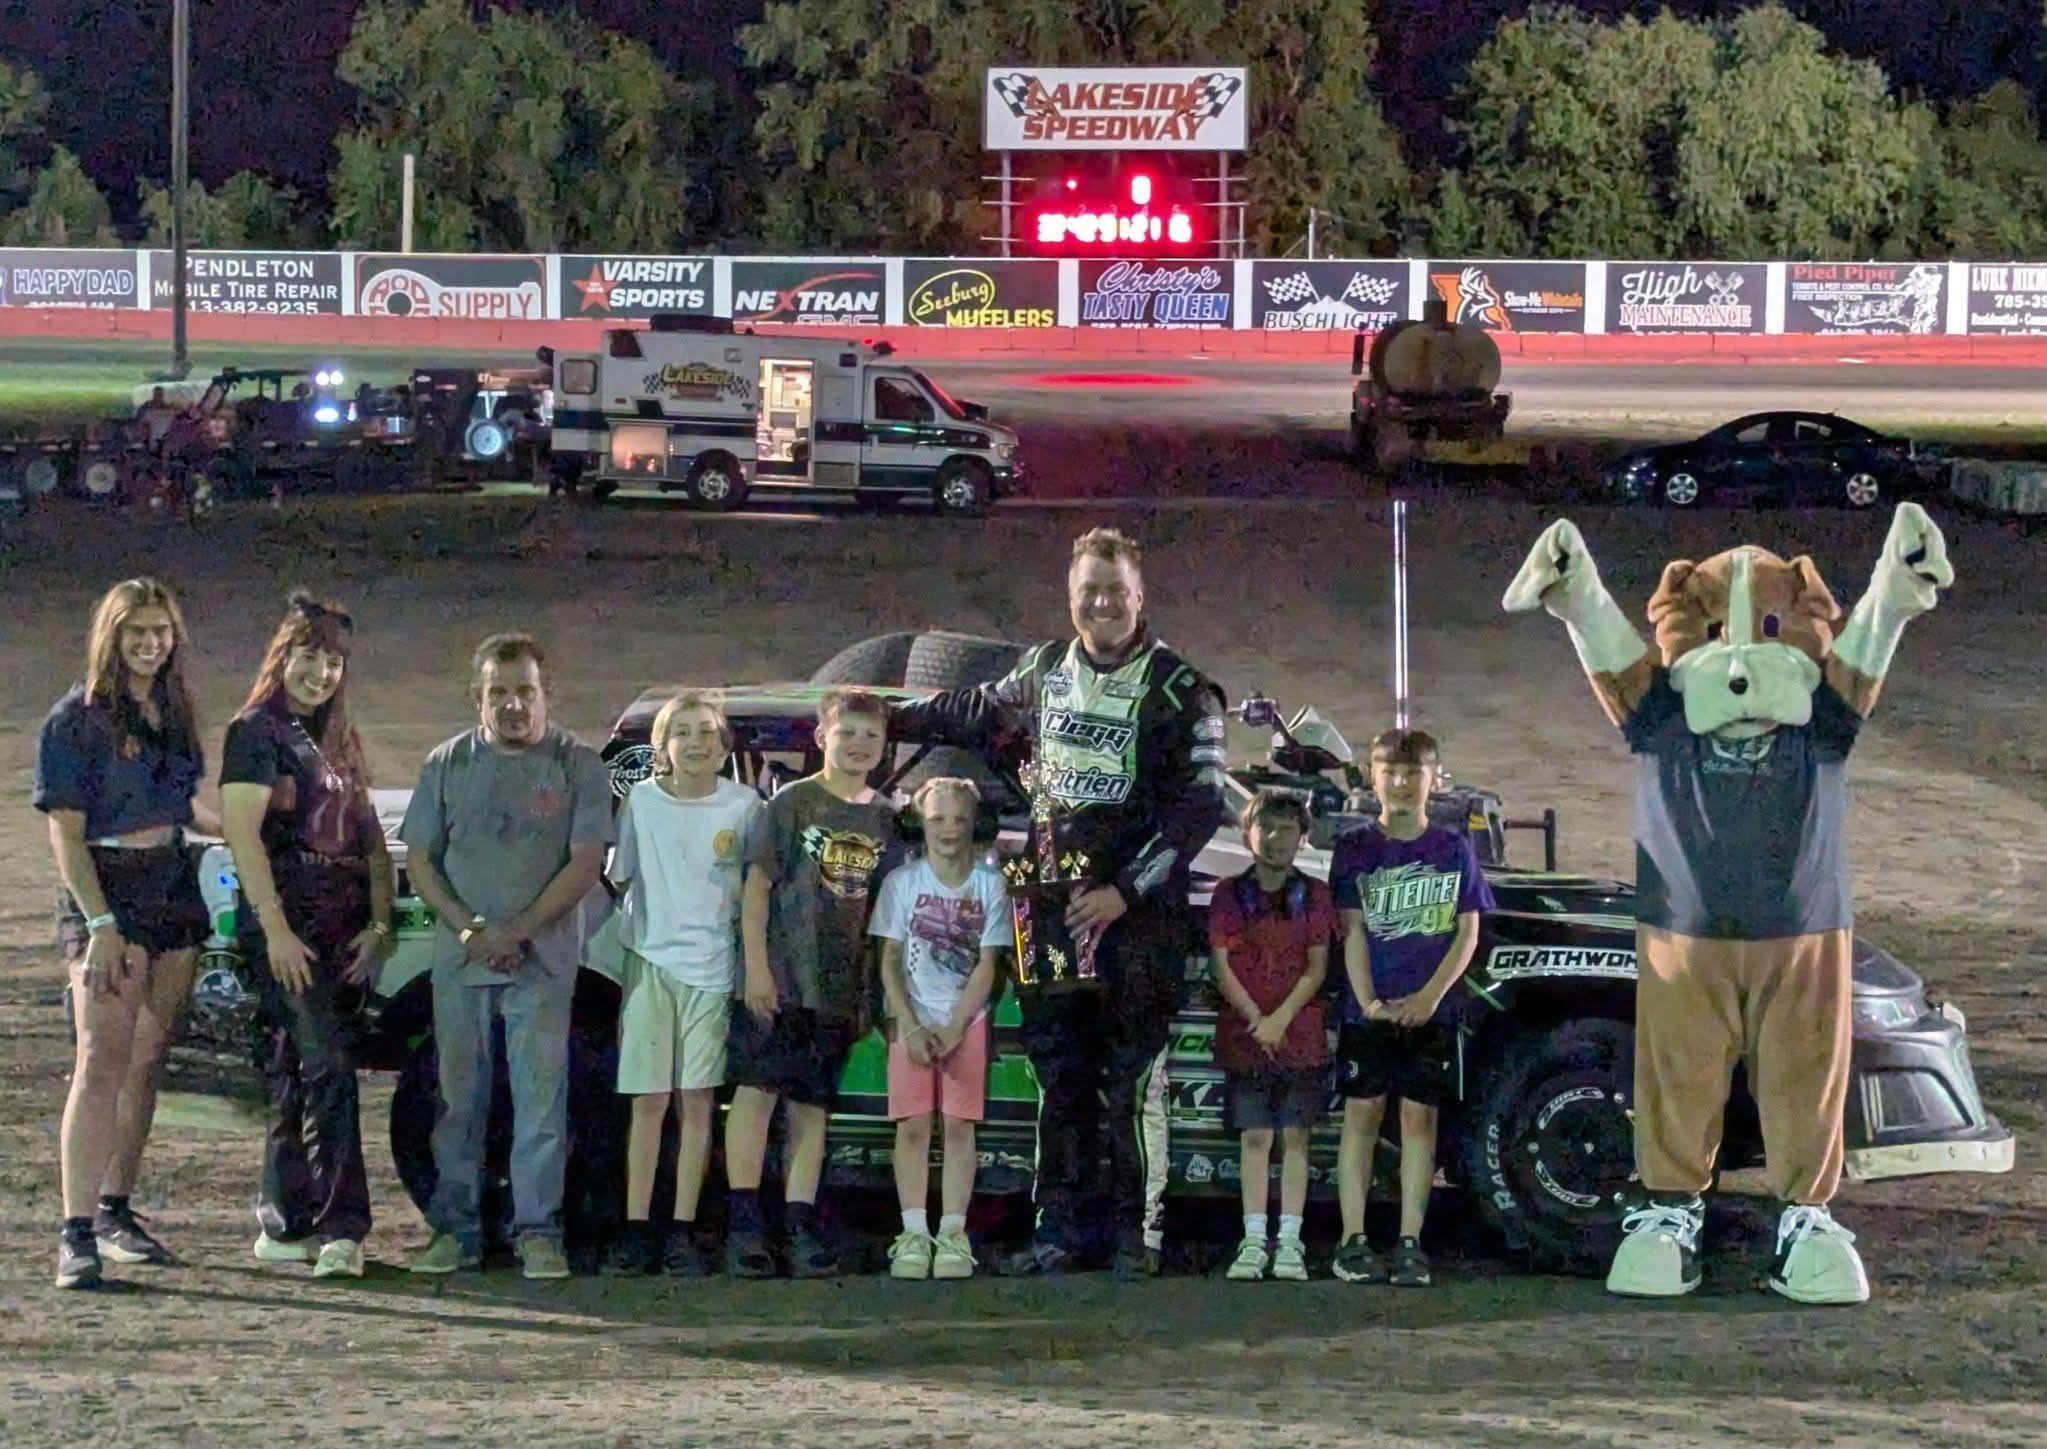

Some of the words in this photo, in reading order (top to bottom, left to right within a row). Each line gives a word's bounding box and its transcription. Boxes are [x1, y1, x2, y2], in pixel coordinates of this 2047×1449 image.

[1025, 80, 1210, 112] LAKESIDE
[1022, 115, 1206, 141] SPEEDWAY
[602, 261, 704, 283] VARSITY
[1096, 261, 1221, 296] Christy's
[1621, 265, 1703, 305] High
[1793, 265, 1837, 280] Pied
[1844, 265, 1897, 283] Piper
[1972, 266, 2009, 292] LUKE
[438, 292, 533, 318] SUPPLY
[609, 288, 705, 308] SPORTS
[735, 289, 880, 312] NEXTRAN
[916, 281, 989, 316] Seeburg
[1083, 292, 1151, 320] TASTY
[1153, 293, 1230, 324] QUEEN
[945, 308, 1054, 328] MUFFLERS
[1618, 303, 1752, 329] MAINTENANCE
[1487, 1123, 1517, 1211] RACER
